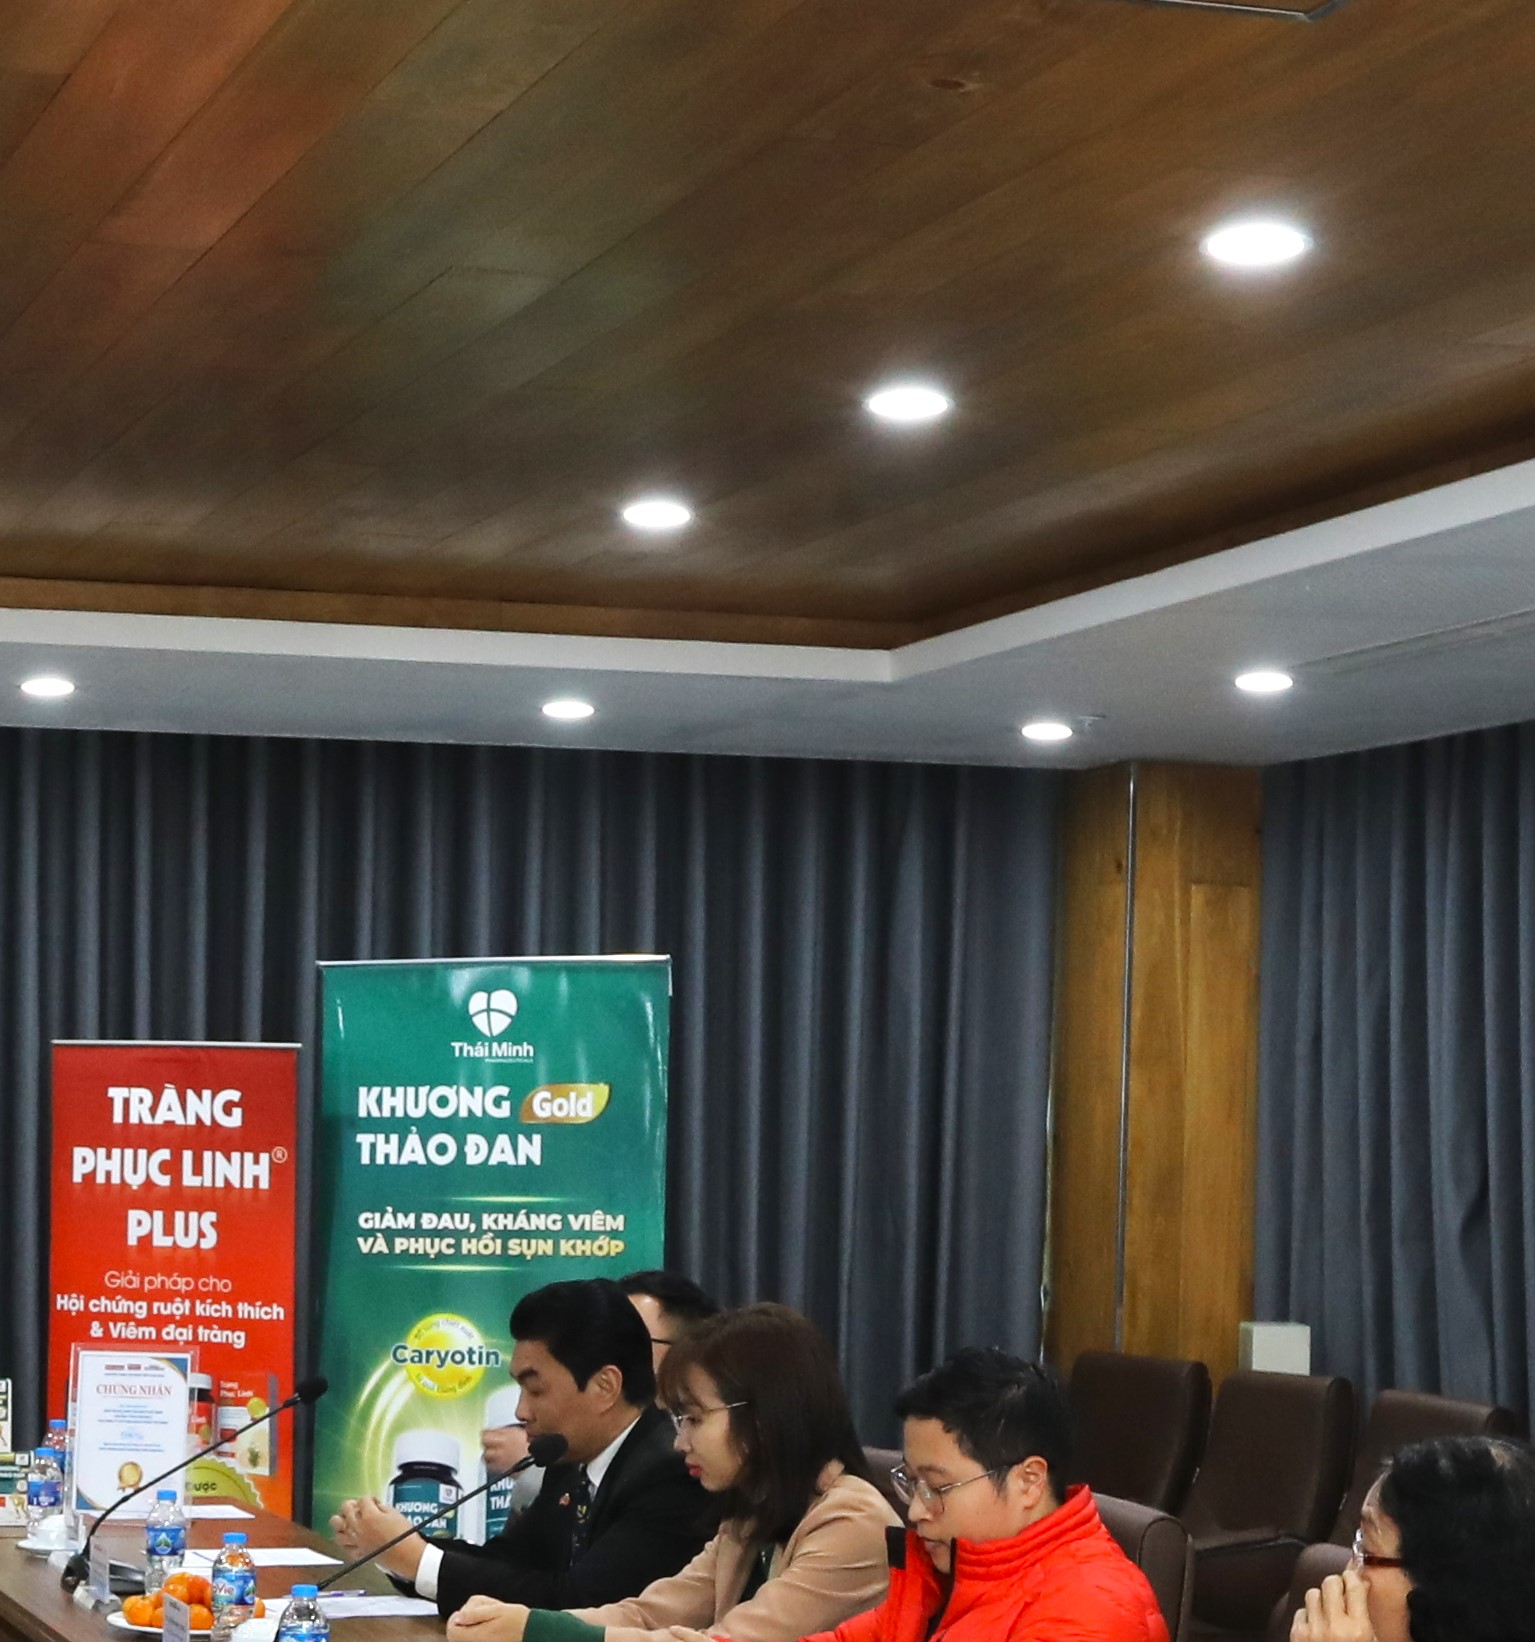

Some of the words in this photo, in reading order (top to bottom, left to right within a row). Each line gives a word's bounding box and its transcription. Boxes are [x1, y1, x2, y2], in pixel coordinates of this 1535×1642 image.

[450, 1041, 490, 1058] Thái
[491, 1041, 535, 1058] Minh
[107, 1083, 243, 1129] TRÀNG
[357, 1083, 512, 1119] KHƯƠNG
[531, 1090, 594, 1119] Gold
[355, 1126, 459, 1166] THẢO
[463, 1133, 543, 1167] ĐAN
[72, 1146, 172, 1191] PHỤC
[126, 1208, 219, 1250] PLUS
[357, 1205, 417, 1231] GIẢM
[420, 1211, 477, 1234] ĐAU,
[481, 1208, 563, 1232] KHÁNG
[567, 1209, 626, 1233] VIÊM
[356, 1232, 390, 1256] VÀ
[393, 1236, 457, 1261] PHỤC
[460, 1232, 502, 1257] HỒI
[507, 1237, 554, 1261] SỤN
[558, 1234, 626, 1258] KHỚP
[103, 1269, 141, 1290] Giải
[143, 1272, 195, 1293] pháp
[198, 1275, 233, 1293] cho
[55, 1292, 85, 1317] Hội
[88, 1295, 148, 1319] chứng
[152, 1296, 191, 1320] ruột
[195, 1298, 233, 1319] kích
[236, 1300, 286, 1321] thích
[89, 1320, 104, 1339] &
[108, 1320, 157, 1341] Viêm
[161, 1322, 194, 1346] đại
[197, 1325, 247, 1350] tràng
[391, 1343, 503, 1369] Caryotin
